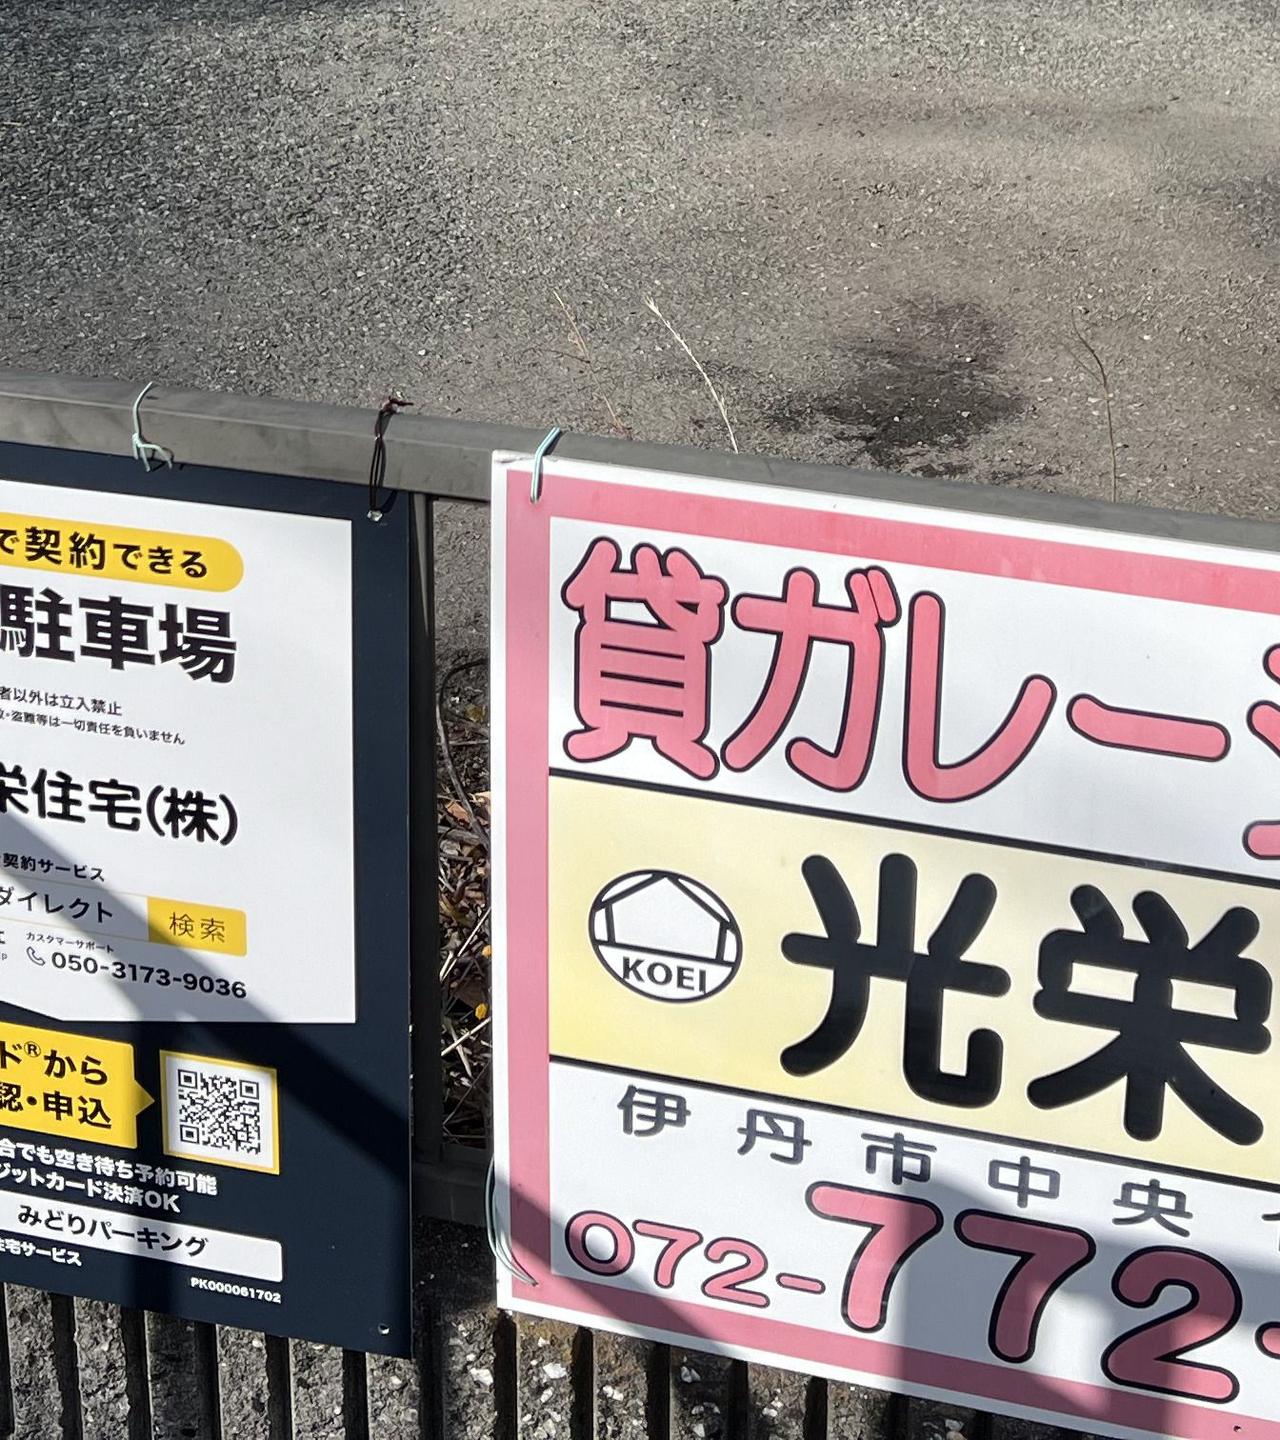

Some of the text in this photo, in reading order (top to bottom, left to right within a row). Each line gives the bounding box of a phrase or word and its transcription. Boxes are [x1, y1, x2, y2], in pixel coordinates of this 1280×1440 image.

[25, 931, 115, 955] カスタマーサポート
[169, 913, 226, 943] 検索
[51, 950, 248, 1000] 050-3173-9036
[620, 957, 709, 999] KOEI
[18, 1204, 208, 1258] みどりパーキング
[190, 1277, 281, 1304] PK000061702
